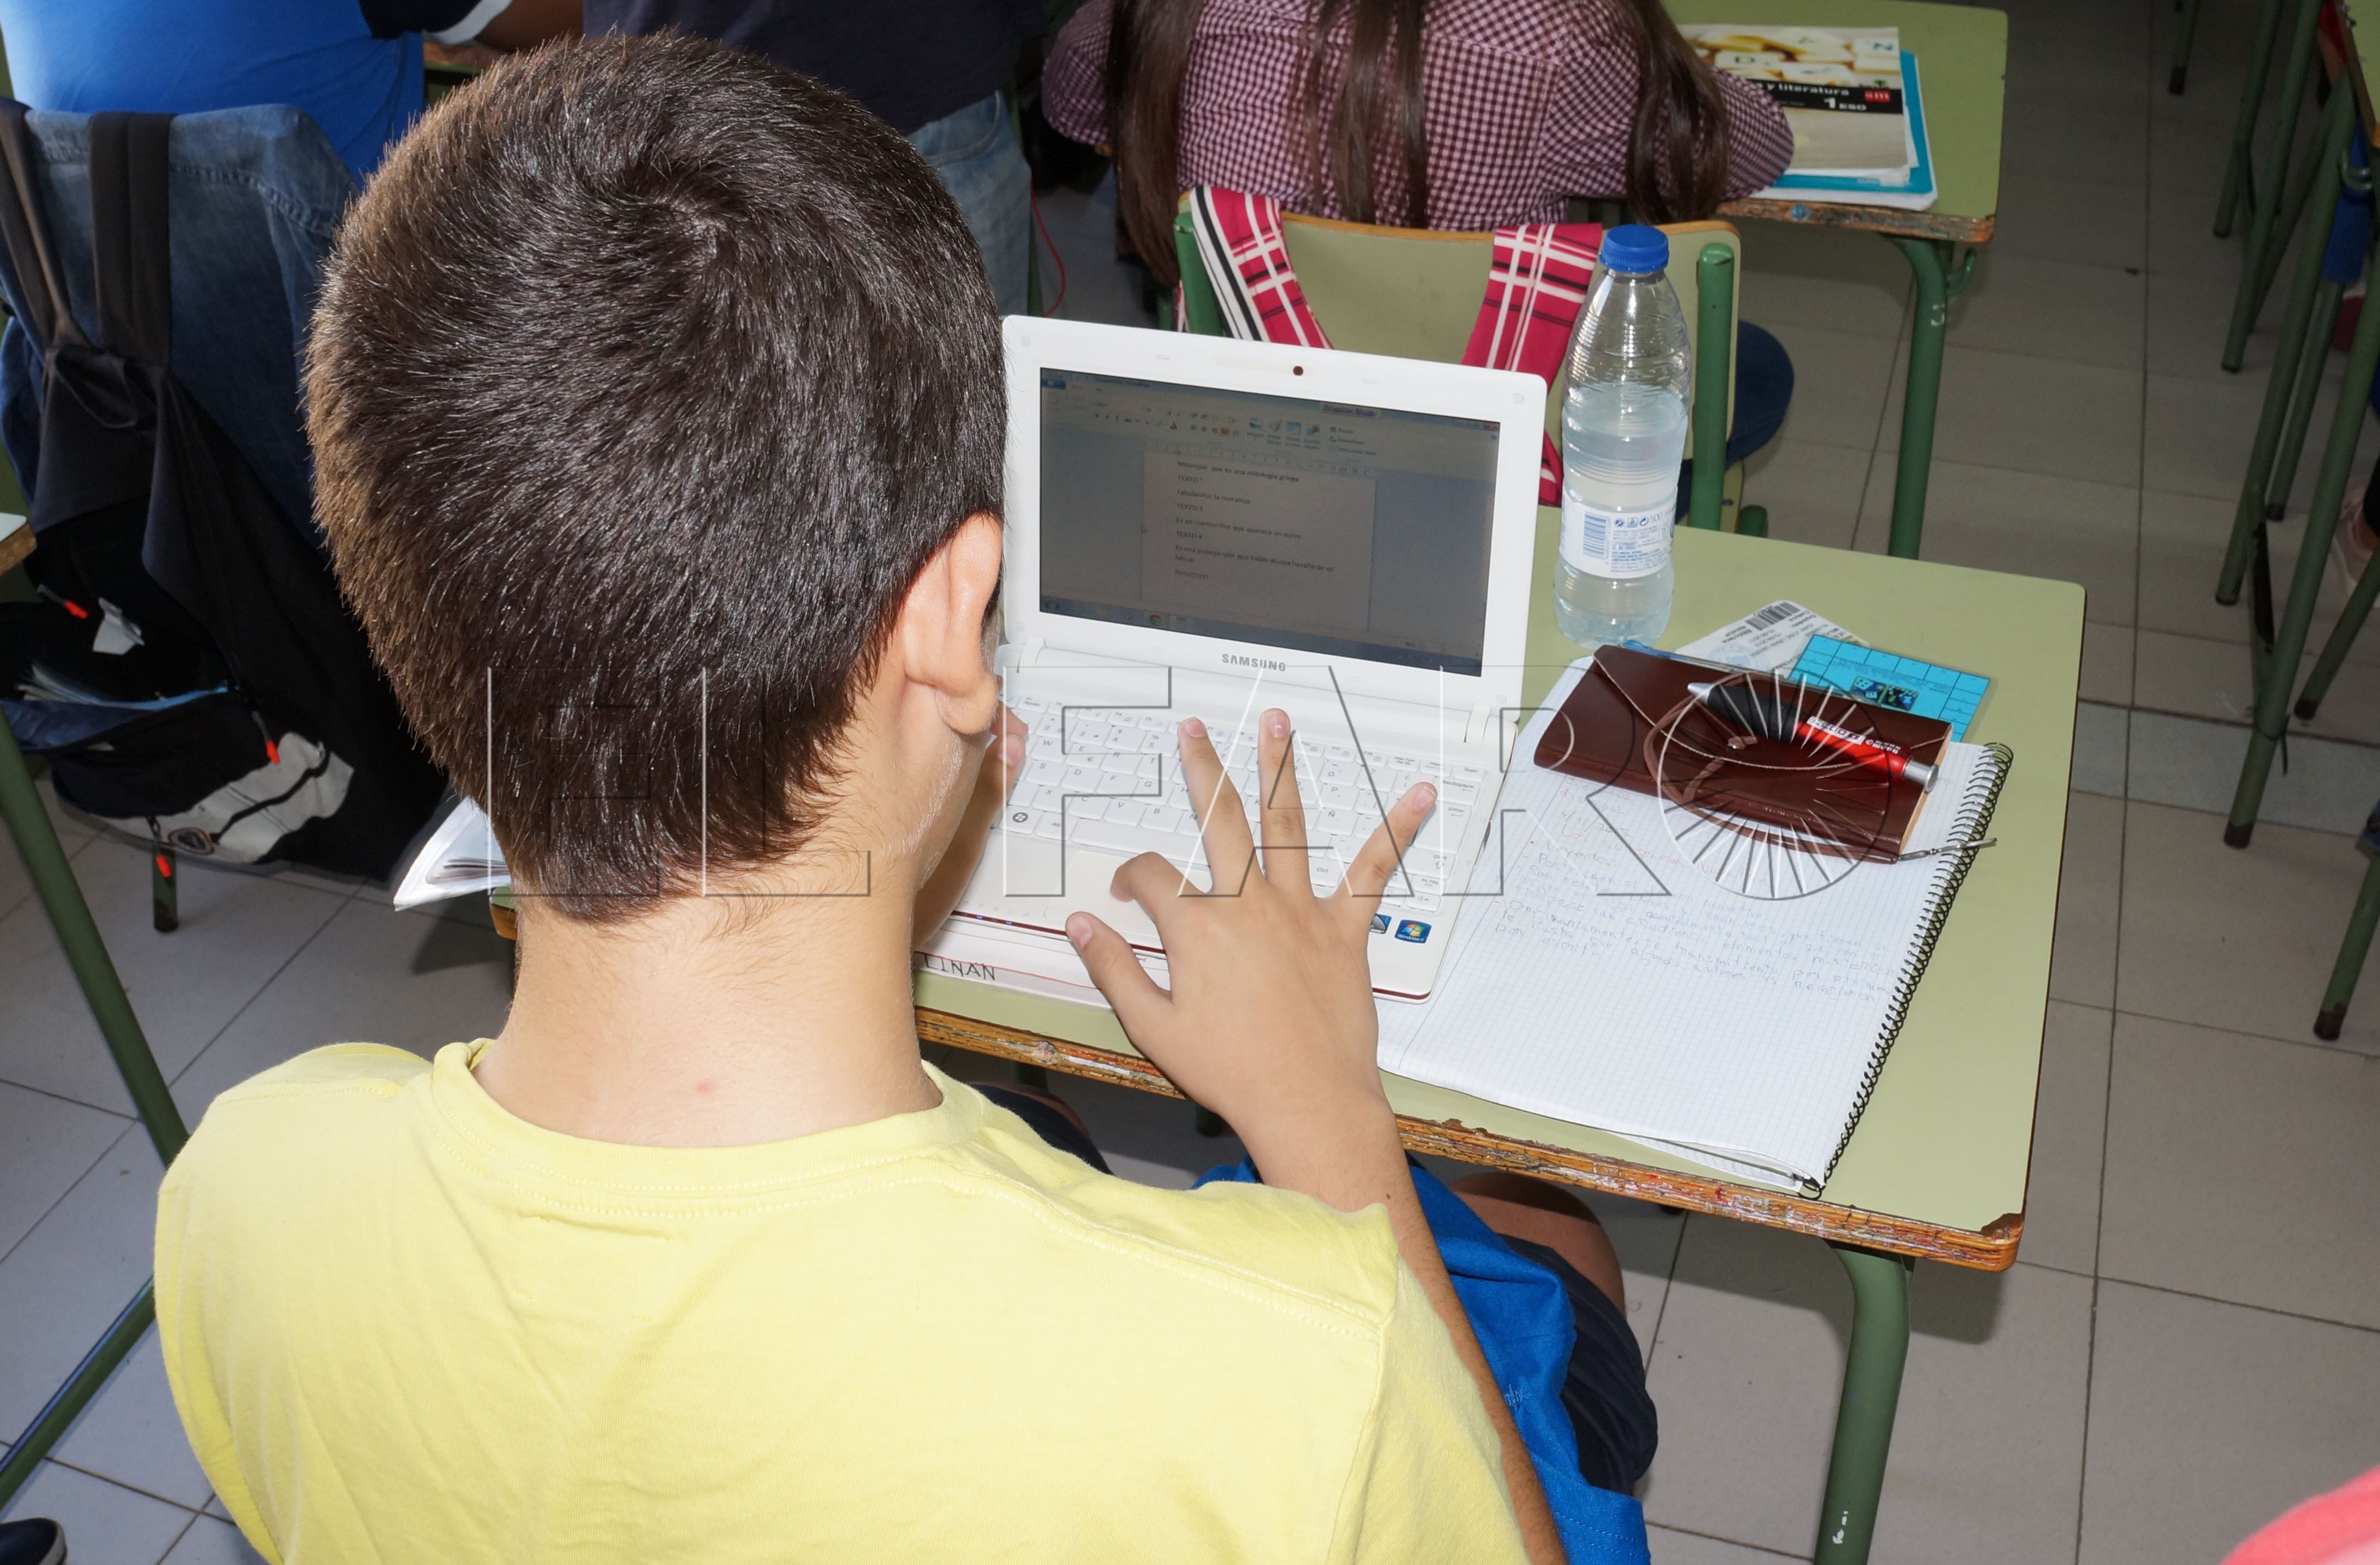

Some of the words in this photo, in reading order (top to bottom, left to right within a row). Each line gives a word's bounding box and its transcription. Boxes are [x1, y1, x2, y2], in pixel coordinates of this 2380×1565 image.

[1778, 82, 1849, 96] literatura
[1824, 97, 1836, 108] 1
[1178, 474, 1199, 483] TEXTO
[1232, 526, 1244, 534] que
[1222, 653, 1286, 672] SAMSUNG
